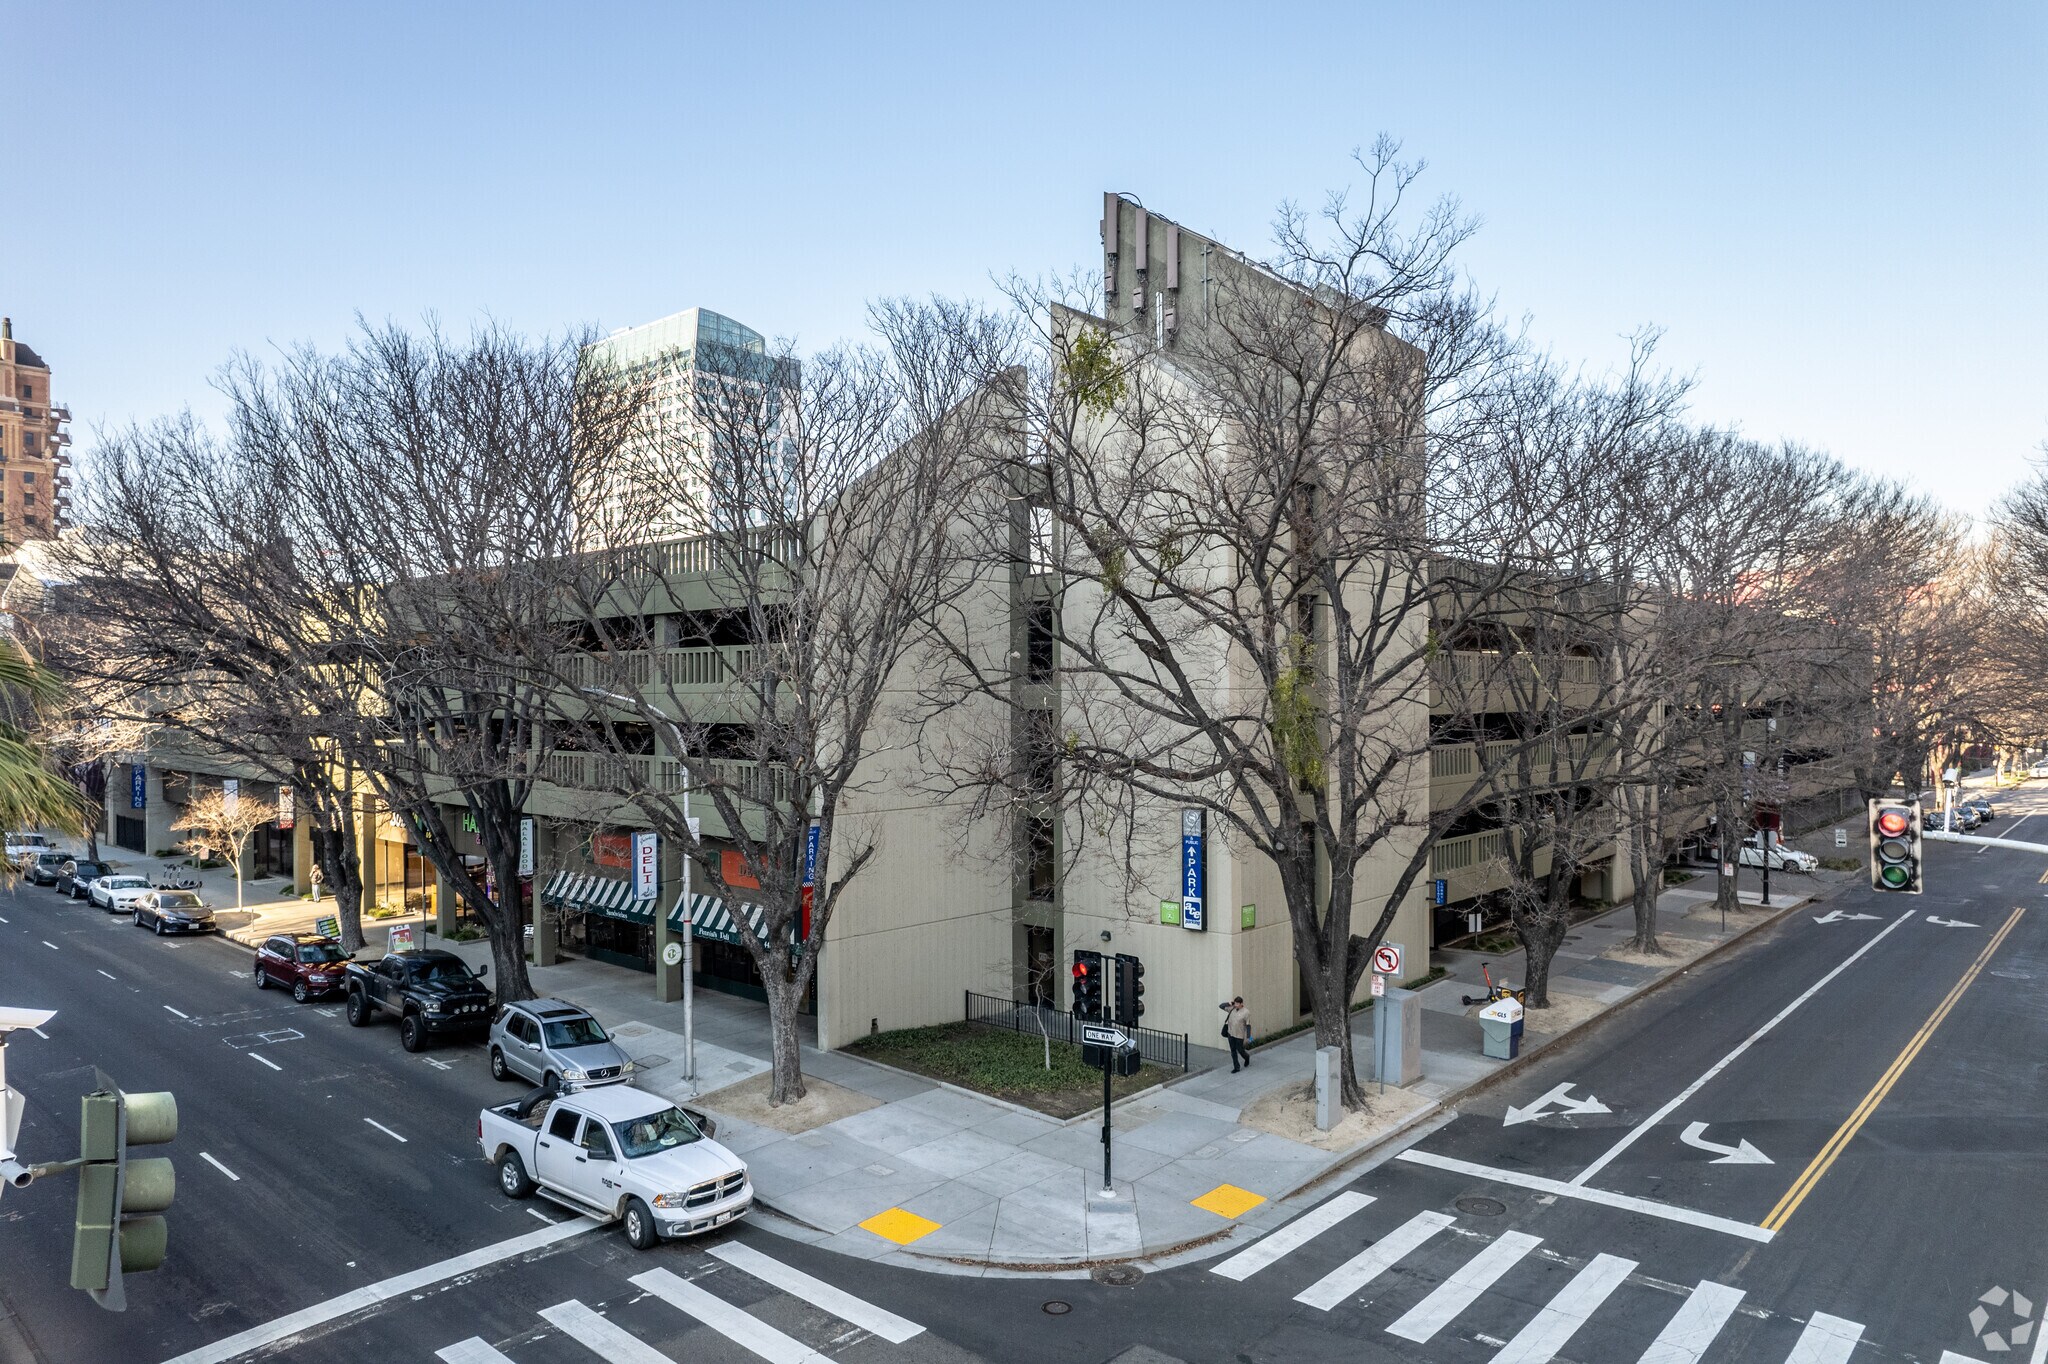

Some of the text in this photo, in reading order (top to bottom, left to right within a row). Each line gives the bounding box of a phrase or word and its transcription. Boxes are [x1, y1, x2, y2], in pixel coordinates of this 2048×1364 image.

[134, 770, 142, 808] PARKING
[642, 846, 653, 884] DELI
[1187, 858, 1197, 897] PARK
[1185, 902, 1200, 919] ace
[719, 930, 730, 941] Deli
[1087, 1031, 1114, 1041] ONE WAY
